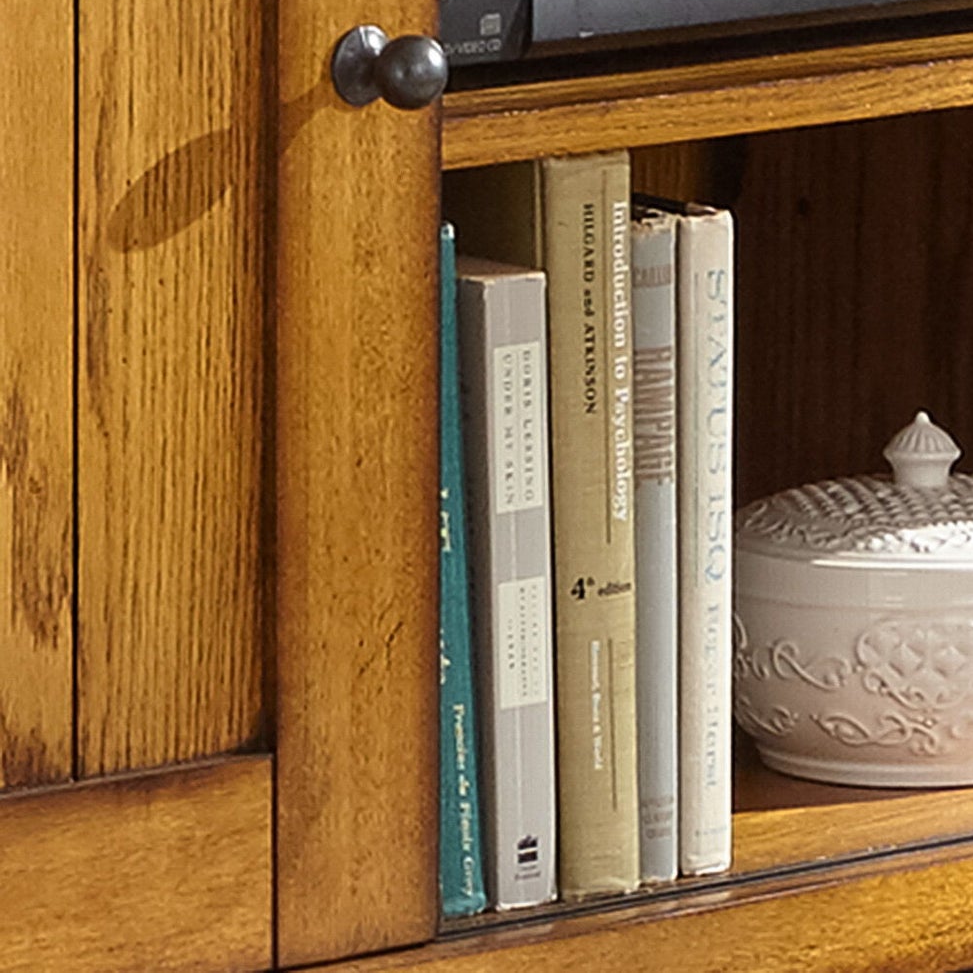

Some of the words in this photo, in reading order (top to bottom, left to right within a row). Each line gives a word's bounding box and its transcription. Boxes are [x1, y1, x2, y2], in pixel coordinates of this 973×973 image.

[582, 203, 595, 283] HILGARD
[612, 201, 629, 348] Introduction
[582, 288, 595, 317] and
[501, 353, 513, 415] UNDER
[520, 350, 532, 408] DORIS
[583, 323, 597, 415] ATKINSON
[612, 355, 628, 380] to
[706, 269, 728, 475] STATUS
[503, 427, 514, 450] MY
[610, 387, 631, 521] Psychology
[632, 345, 674, 490] RAMPAGE
[503, 461, 515, 505] SKIN
[521, 418, 534, 502] LESSING
